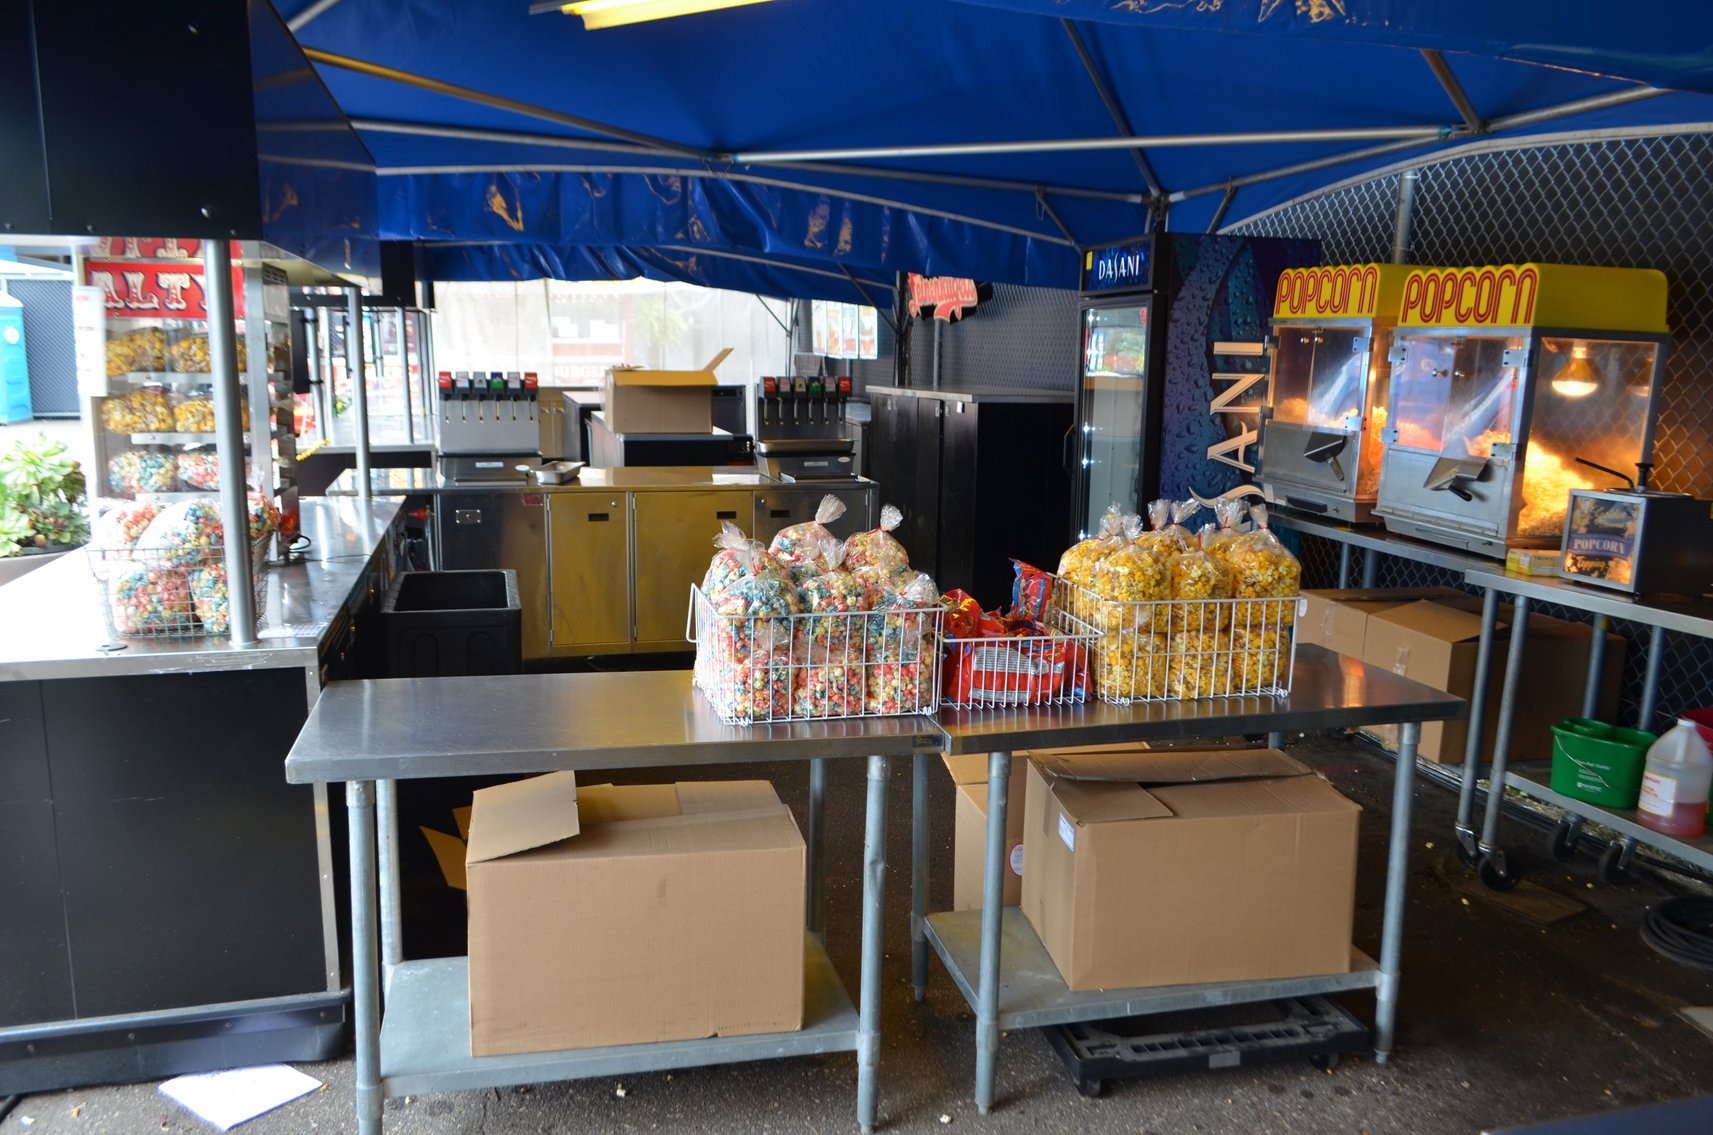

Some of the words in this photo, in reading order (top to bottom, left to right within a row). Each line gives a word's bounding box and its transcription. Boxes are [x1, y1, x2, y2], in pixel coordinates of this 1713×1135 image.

[1099, 252, 1140, 283] DASANI
[91, 270, 208, 310] ALT
[1573, 537, 1626, 554] POPCORN
